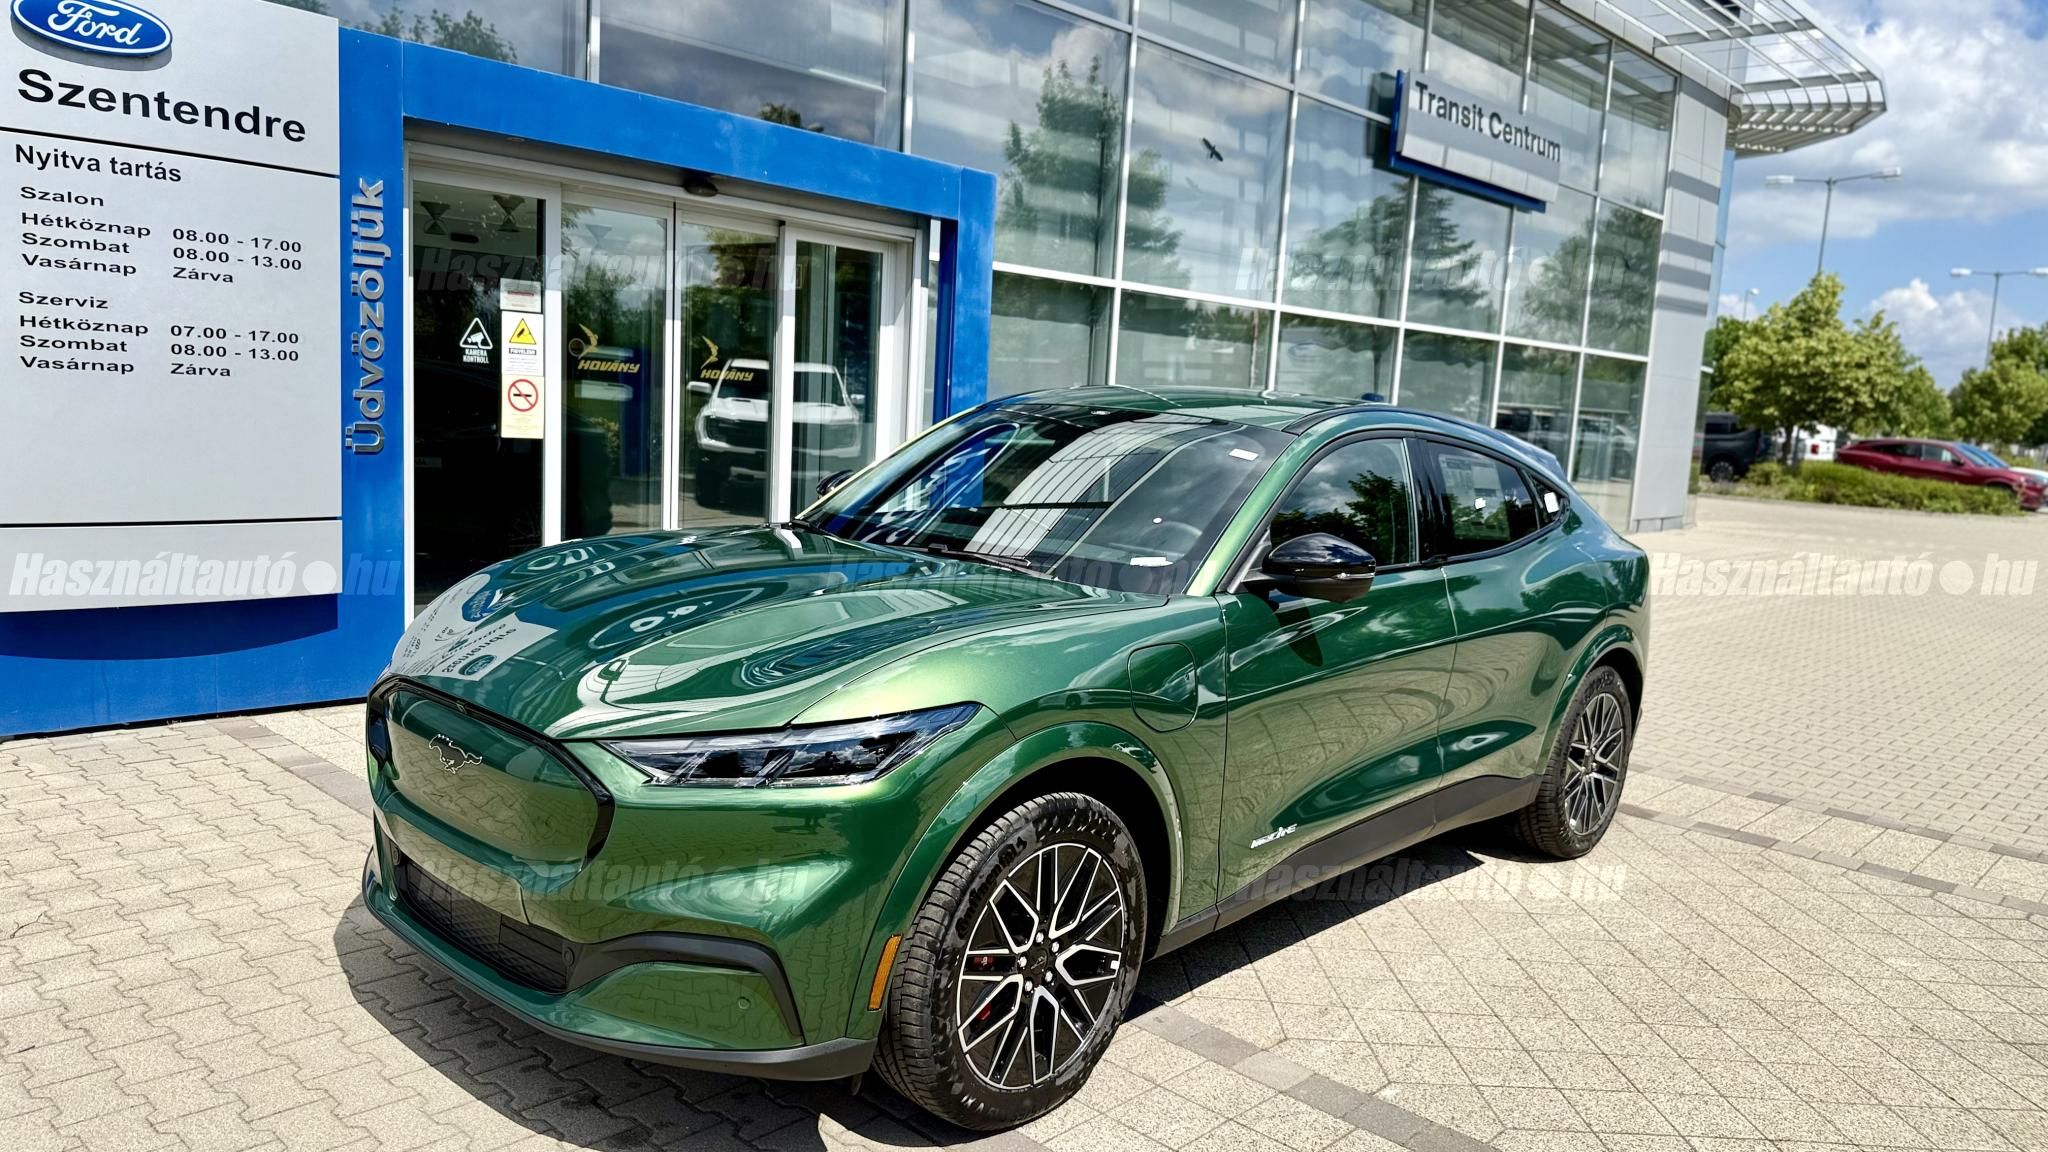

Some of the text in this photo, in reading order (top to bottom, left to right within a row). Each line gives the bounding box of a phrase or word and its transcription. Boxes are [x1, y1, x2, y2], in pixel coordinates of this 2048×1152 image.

[48, 2, 142, 46] Ford
[17, 68, 306, 143] Szentendre
[1415, 81, 1561, 163] Transit Centrum
[15, 143, 182, 182] Nyitva tartás
[20, 186, 105, 207] Szalon
[20, 212, 151, 238] Hétköznap
[172, 228, 230, 245] 08.00
[251, 237, 302, 254] 17.00
[21, 232, 131, 255] Szombat
[172, 247, 230, 264] 08.00
[251, 255, 302, 271] 13.00
[21, 253, 234, 284] Vasárnap Zárva
[18, 291, 109, 309] Szerviz
[345, 178, 391, 455] Üdvözöljük
[19, 315, 149, 336] Hétköznap
[170, 324, 227, 340] 07.00
[248, 330, 300, 344] 17.00
[19, 335, 129, 353] Szombat
[170, 343, 228, 358] 08.00
[248, 347, 300, 362] 13.00
[19, 355, 232, 377] Vasárnap Zárva
[462, 355, 490, 364] KONTROLL
